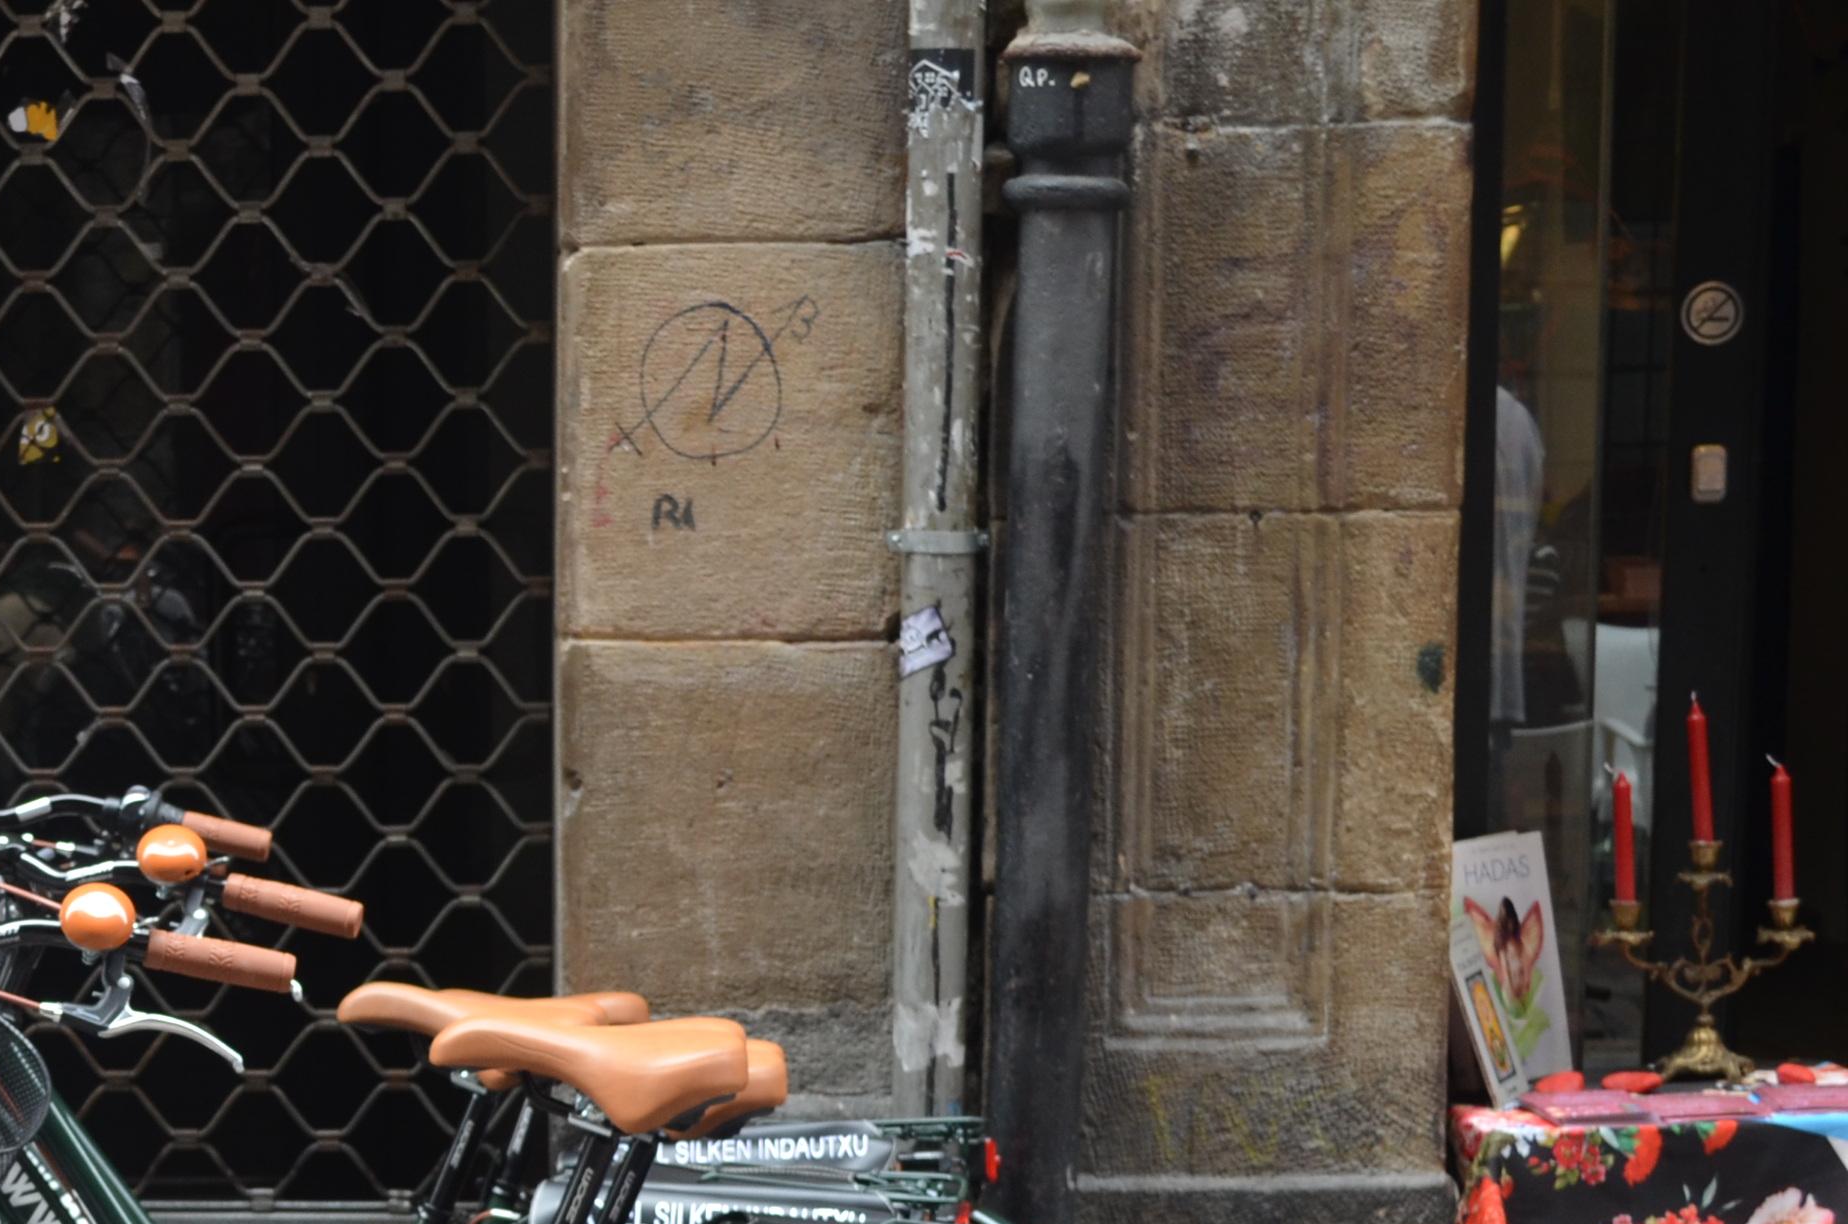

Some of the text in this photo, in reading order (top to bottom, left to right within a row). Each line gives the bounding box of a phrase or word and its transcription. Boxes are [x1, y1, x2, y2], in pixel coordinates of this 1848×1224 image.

[1463, 855, 1531, 886] HADAS
[674, 1137, 753, 1164] SILKEN
[758, 1134, 869, 1160] INDAUTXU
